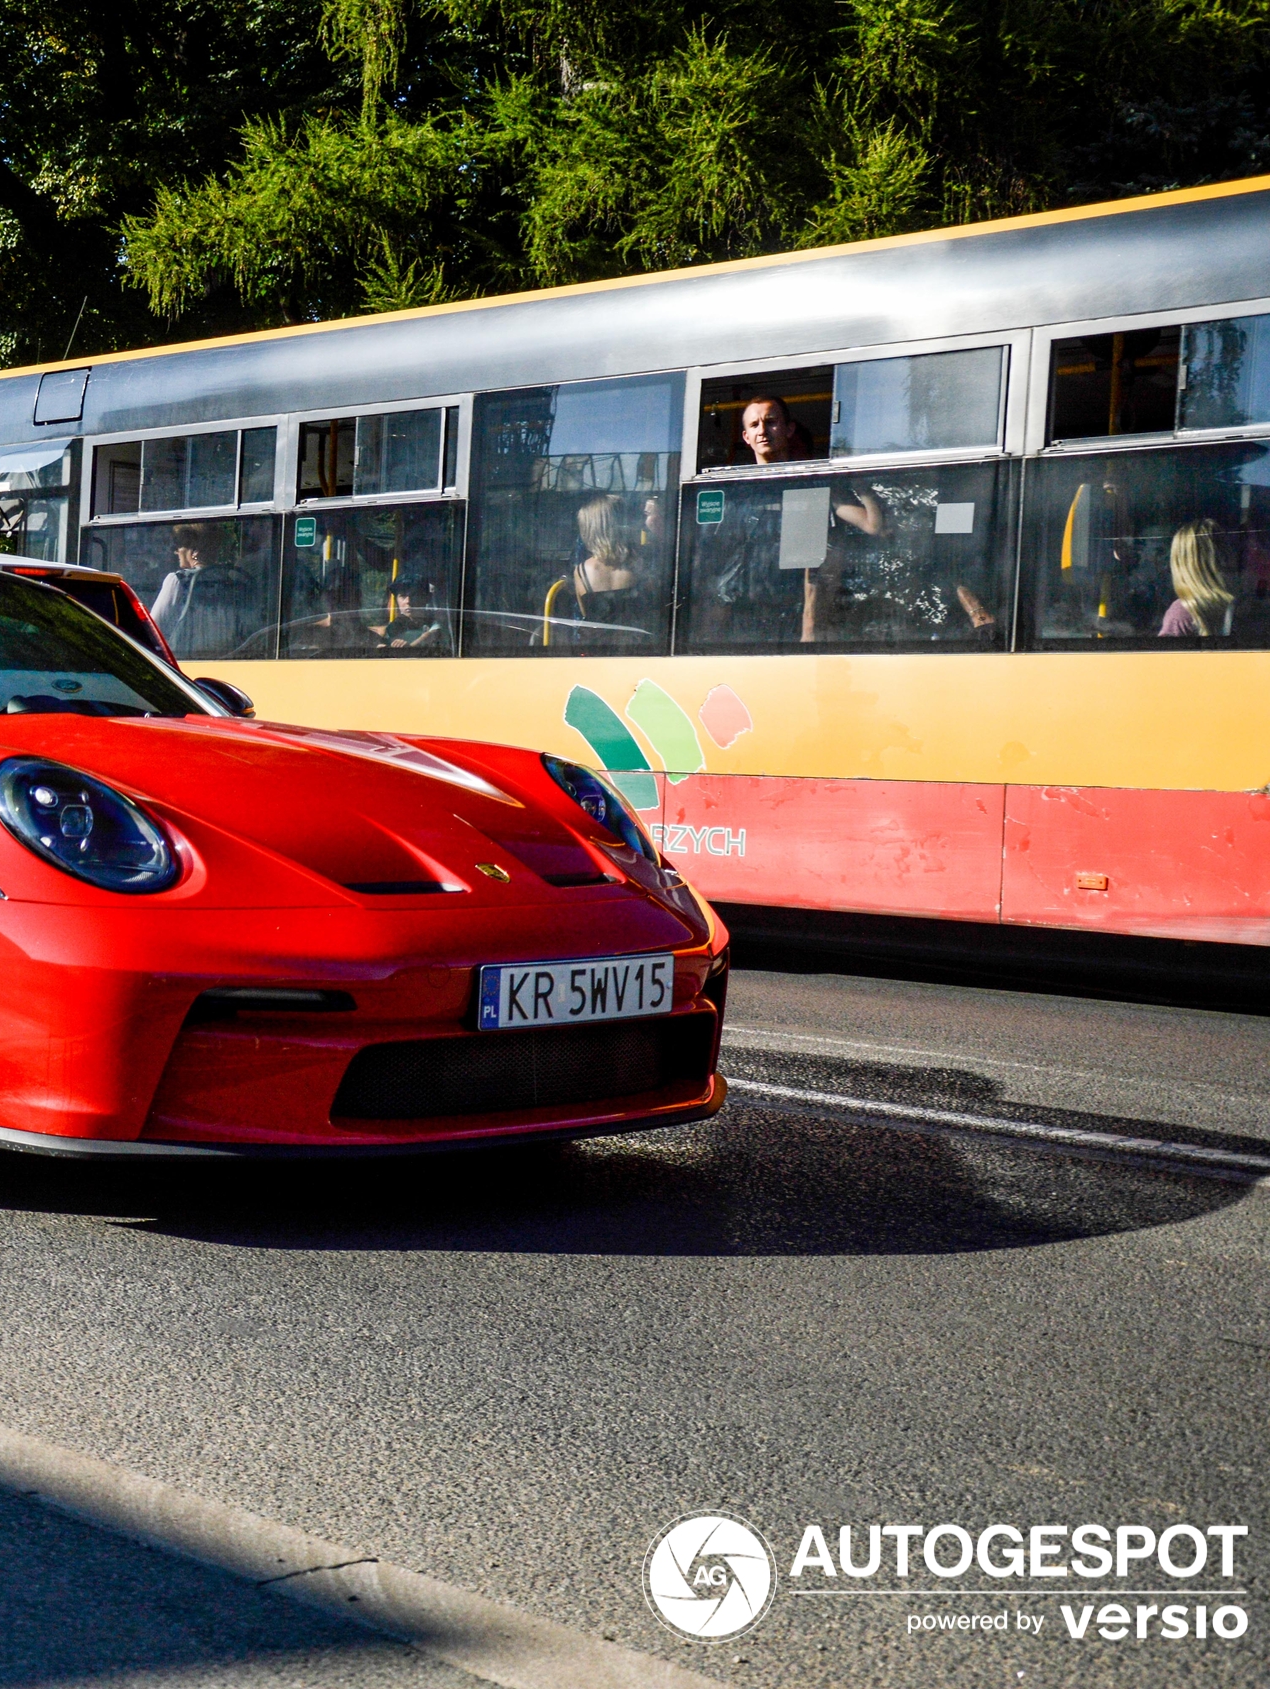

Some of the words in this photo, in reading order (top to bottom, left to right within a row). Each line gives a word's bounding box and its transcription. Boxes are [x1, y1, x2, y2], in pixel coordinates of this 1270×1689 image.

[644, 823, 747, 857] RZYCH
[508, 971, 554, 1021] KR
[568, 962, 666, 1016] 5WV15
[483, 1005, 497, 1019] PL
